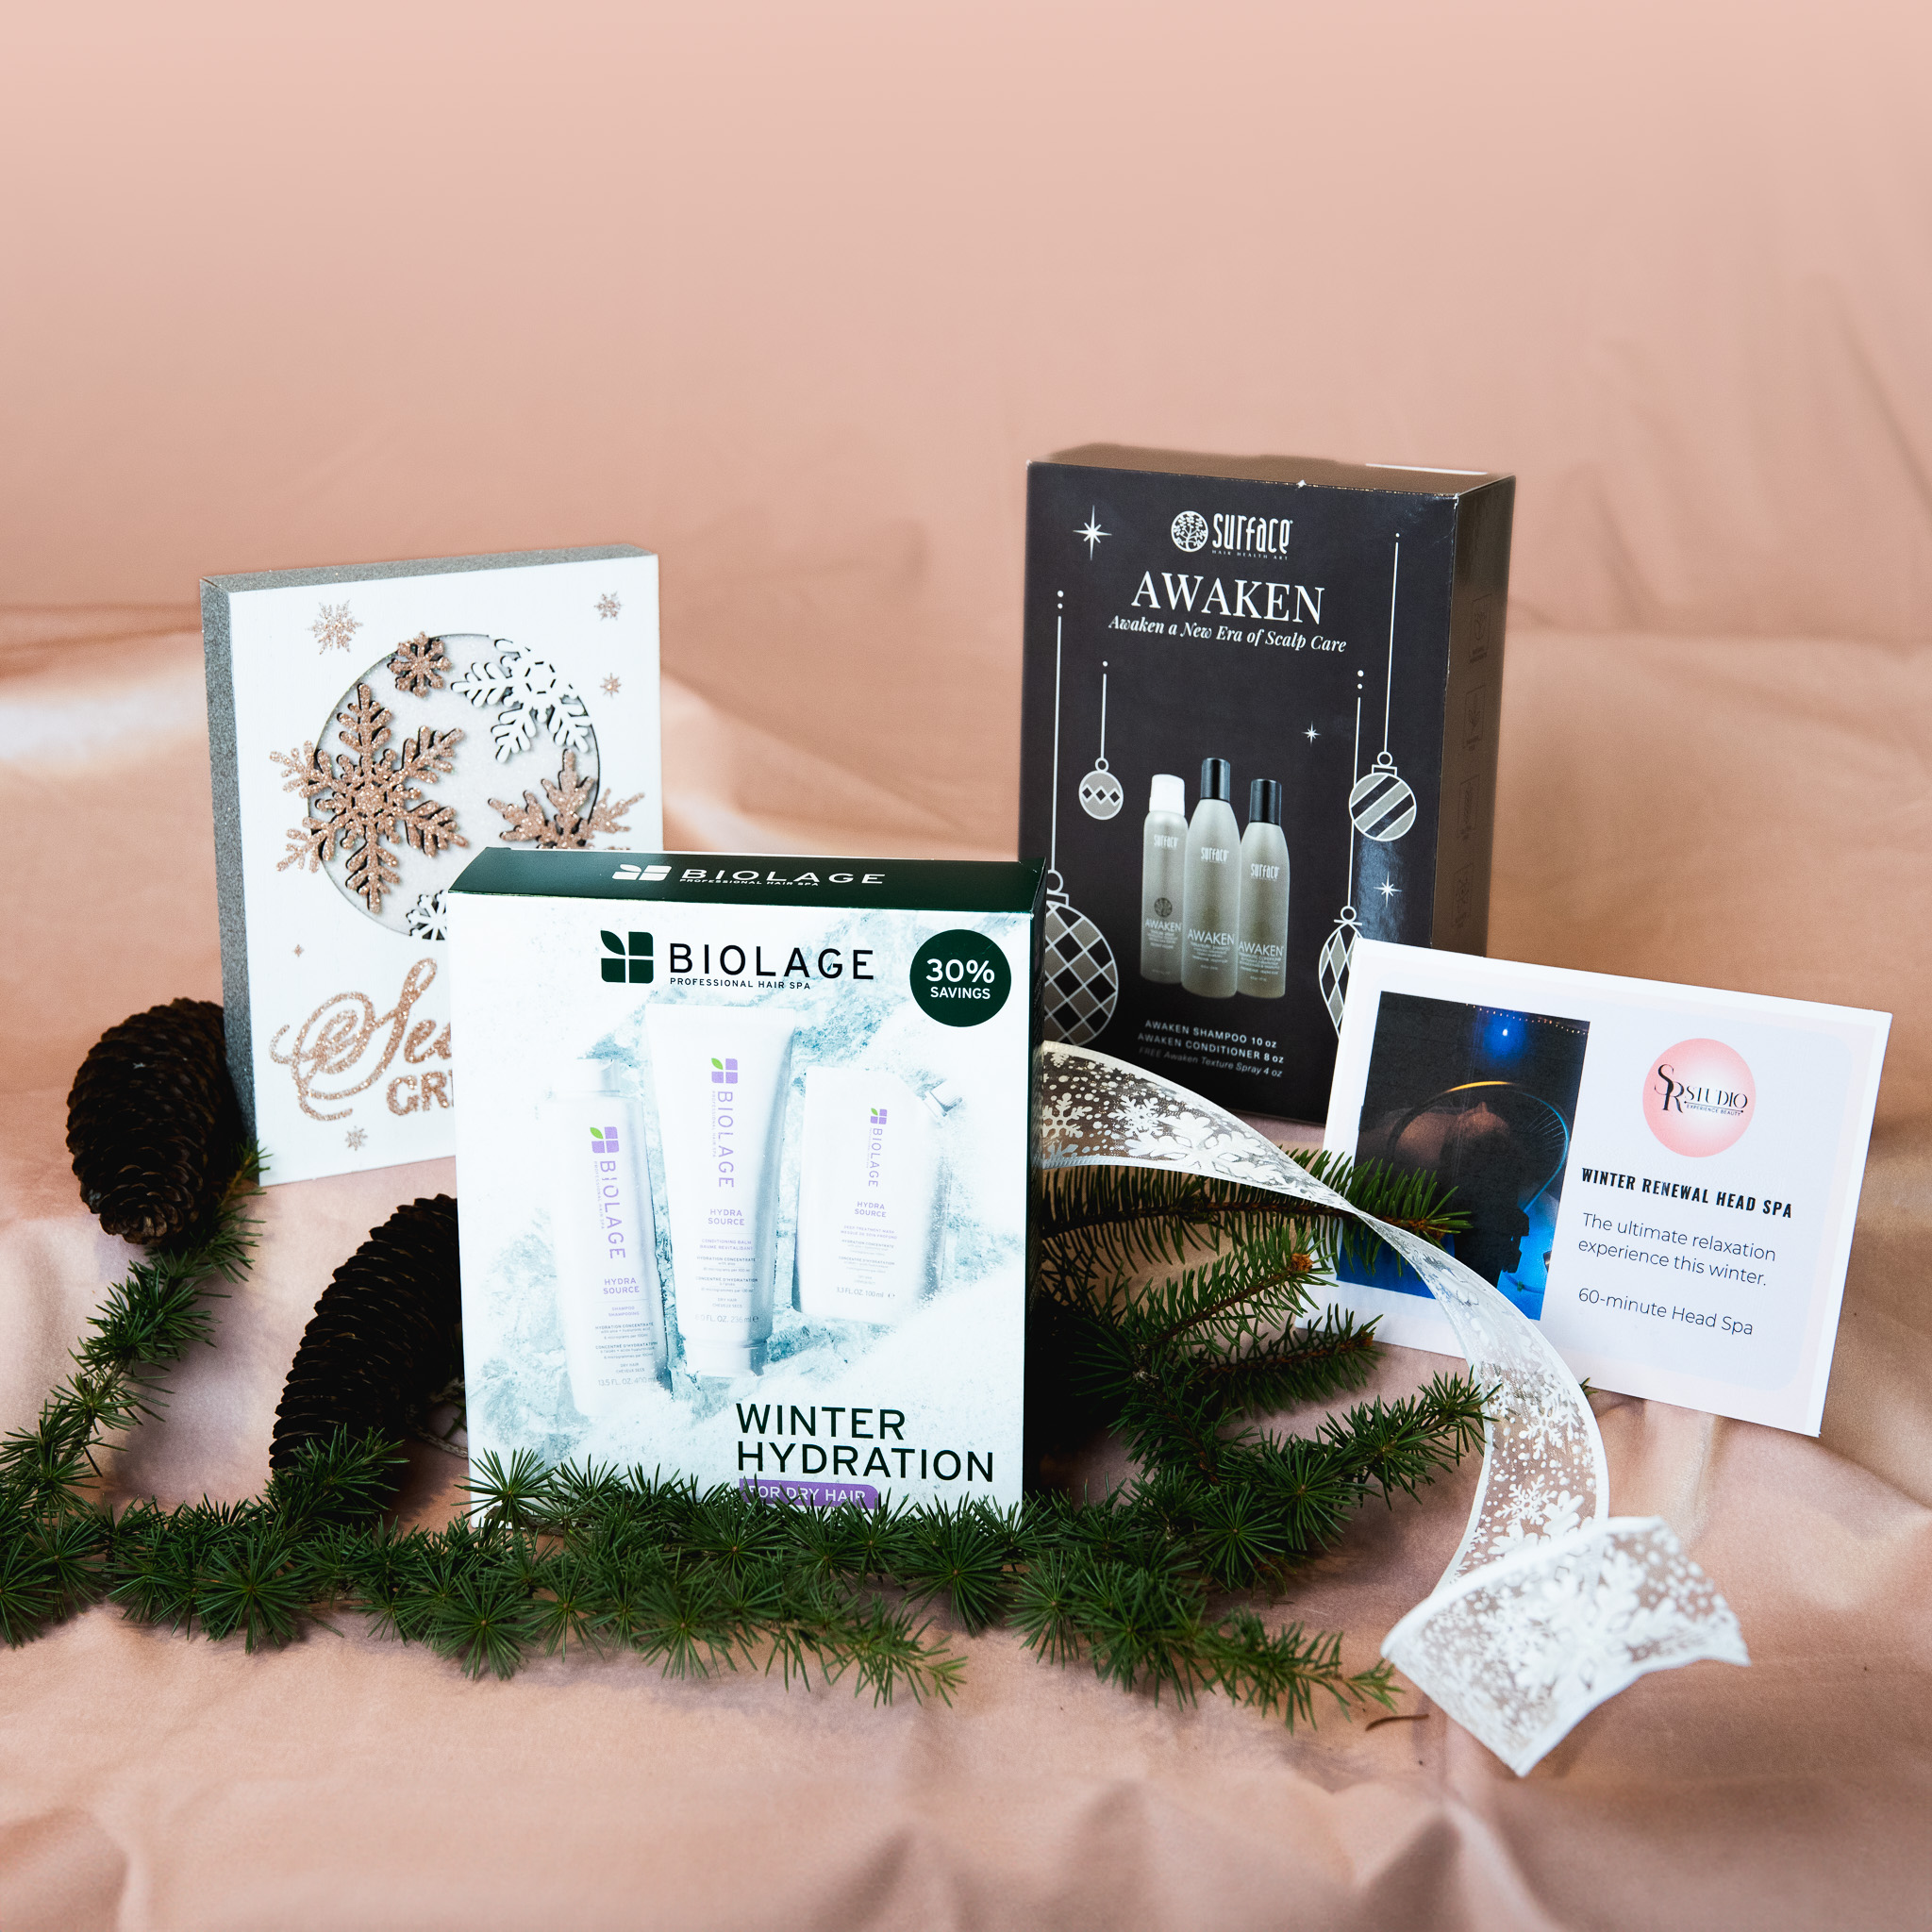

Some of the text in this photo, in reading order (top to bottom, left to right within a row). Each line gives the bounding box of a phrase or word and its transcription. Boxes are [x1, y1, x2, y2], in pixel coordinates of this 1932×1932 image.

[1131, 571, 1325, 625] AWAKEN
[1108, 615, 1347, 653] Awaken a New Era of Scalp Care
[681, 869, 886, 884] BIOLAGE
[1145, 919, 1181, 932] AWAKEN
[1188, 928, 1235, 945] AWAKEN
[669, 943, 874, 980] BIOLAGE
[1239, 941, 1283, 957] AWAKEN
[670, 977, 811, 991] PROFESSIONAL HAIR SPA
[926, 958, 995, 985] 30%
[930, 986, 991, 1000] SAVINGS
[1144, 1020, 1190, 1035] AWAKEN
[1192, 1026, 1247, 1044] SHAMPOO
[1251, 1037, 1263, 1046] 10
[1138, 1032, 1182, 1047] AWAKEN
[1185, 1040, 1260, 1060] CONDITIONER
[1264, 1052, 1270, 1061] 8
[1139, 1046, 1161, 1058] FREE
[1163, 1051, 1198, 1064] Awaken
[1201, 1056, 1234, 1070] Texture
[1235, 1061, 1262, 1075] Spray
[1263, 1067, 1269, 1075] 4
[387, 1070, 454, 1115] GR
[1685, 1085, 1748, 1108] STUDIO
[1686, 1105, 1740, 1117] EXPERIENCE BEAUTY
[718, 1091, 734, 1188] BIOLAGE
[868, 1128, 883, 1187] BIOLAGE
[858, 1201, 885, 1209] HYDRA
[1581, 1168, 1793, 1219] WINTER RENEWAL HEAD SPA
[600, 1160, 626, 1258] BIOLAGE
[708, 1217, 745, 1225] SOURCE
[710, 1208, 742, 1217] HYDRA
[854, 1208, 887, 1217] SOURCE
[1583, 1212, 1776, 1262] The ultimate relaxation
[1578, 1241, 1767, 1286] experience this winter.
[603, 1286, 640, 1295] SOURCE
[604, 1277, 637, 1286] HYDRA
[1578, 1288, 1754, 1337] 60-minute Head Spa
[736, 1402, 907, 1441] WINTER
[737, 1441, 994, 1483] HYDRATION
[786, 1487, 819, 1500] DRY
[825, 1489, 866, 1502] HAIR
